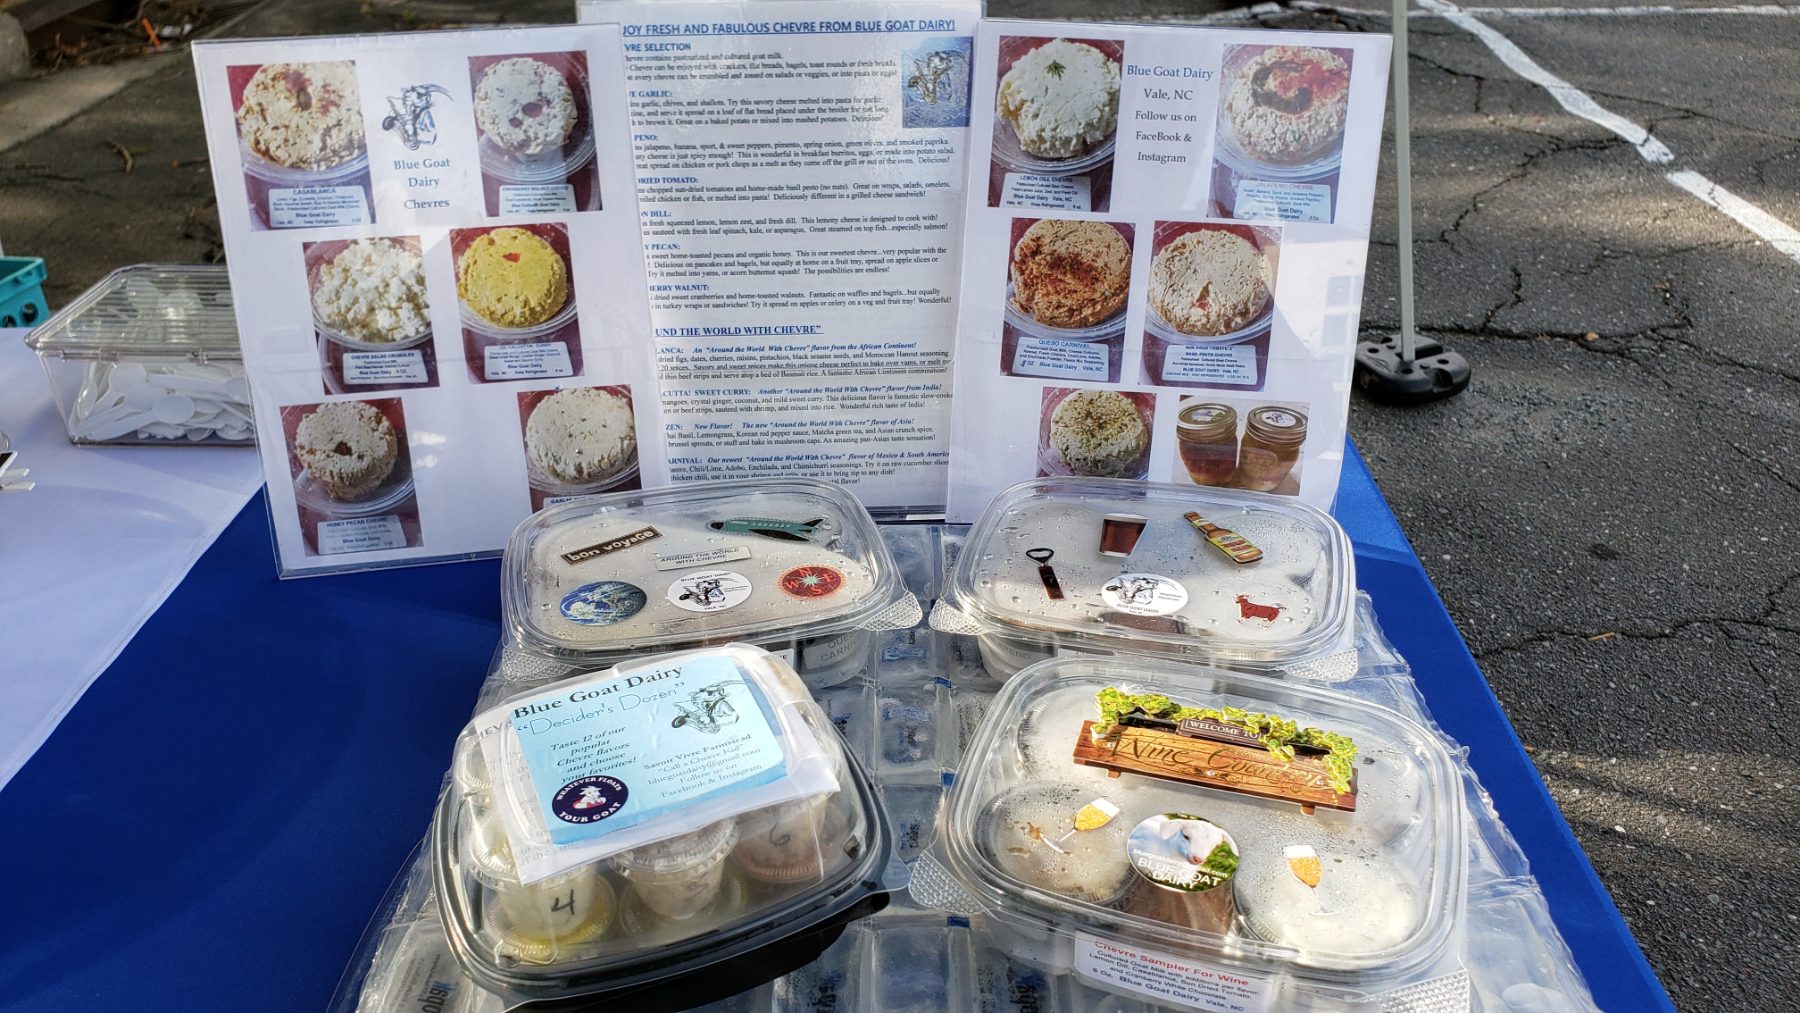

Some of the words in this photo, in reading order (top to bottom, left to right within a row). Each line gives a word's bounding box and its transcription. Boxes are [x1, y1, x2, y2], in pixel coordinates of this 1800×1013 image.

[646, 24, 680, 34] FRESH
[684, 24, 708, 34] AND
[713, 23, 769, 33] FABULOUS
[773, 21, 816, 32] CHEVRE
[820, 22, 851, 31] FROM
[856, 21, 882, 30] BLUE
[885, 21, 915, 30] GOAT
[919, 20, 955, 30] DAIRY!
[1127, 65, 1151, 75] Blue
[1154, 66, 1179, 77] Goat
[1184, 68, 1213, 81] Dairy
[1144, 88, 1170, 100] Vale,
[1174, 90, 1193, 100] NC
[1135, 110, 1168, 120] Follow
[1136, 131, 1181, 141] FaceBook
[1184, 134, 1191, 142] &
[394, 160, 419, 170] Blue
[423, 158, 450, 168] Goat
[1138, 152, 1186, 164] Instagram
[408, 176, 440, 189] Dairy
[404, 199, 450, 209] Chevres
[680, 328, 700, 336] THE
[703, 327, 741, 335] WORLD
[745, 327, 771, 335] WITH
[567, 549, 600, 560] bon
[514, 700, 562, 719] Blue
[570, 683, 620, 703] Goat
[626, 666, 682, 688] Dairy
[551, 741, 579, 750] Taste
[609, 727, 625, 735] our
[1189, 720, 1240, 736] WELCOME
[1244, 730, 1258, 739] TO
[557, 754, 593, 766] Chevre
[597, 743, 630, 755] flavors
[571, 740, 610, 756] popular
[644, 759, 673, 770] Savoir
[676, 750, 700, 760] Vivre
[703, 734, 752, 752] Farmstead
[1111, 734, 1192, 766] Wine
[561, 773, 586, 784] your
[589, 757, 636, 775] favorites!
[567, 762, 586, 773] and
[590, 752, 625, 766] choose
[680, 771, 711, 784] Follow
[557, 777, 596, 800] WHATEVER
[599, 777, 622, 791] FLOATS
[662, 782, 706, 798] Facebook
[560, 812, 588, 822] YOUR
[593, 802, 621, 820] GOAT
[769, 822, 791, 847] 6
[1138, 858, 1173, 873] BLUE
[1179, 869, 1221, 886] GOAT
[1152, 871, 1198, 888] DAIRY
[552, 889, 575, 915] 4
[1090, 953, 1114, 964] Lemon
[1181, 979, 1195, 987] Sun
[1198, 983, 1218, 992] Dried
[1097, 950, 1128, 963] Cultured
[1131, 960, 1148, 970] Goat
[1151, 966, 1165, 974] Milk
[1168, 970, 1182, 978] with
[1186, 975, 1219, 987] additions
[1222, 983, 1234, 991] per
[1110, 966, 1123, 974] and
[1125, 970, 1162, 985] Cranberry
[1165, 981, 1186, 990] White
[1140, 954, 1190, 972] Sampler
[1194, 968, 1213, 978] For
[1218, 974, 1248, 985] Wine
[1119, 975, 1142, 987] Blue
[1145, 983, 1170, 994] Goat
[1173, 990, 1200, 1002] Dairy
